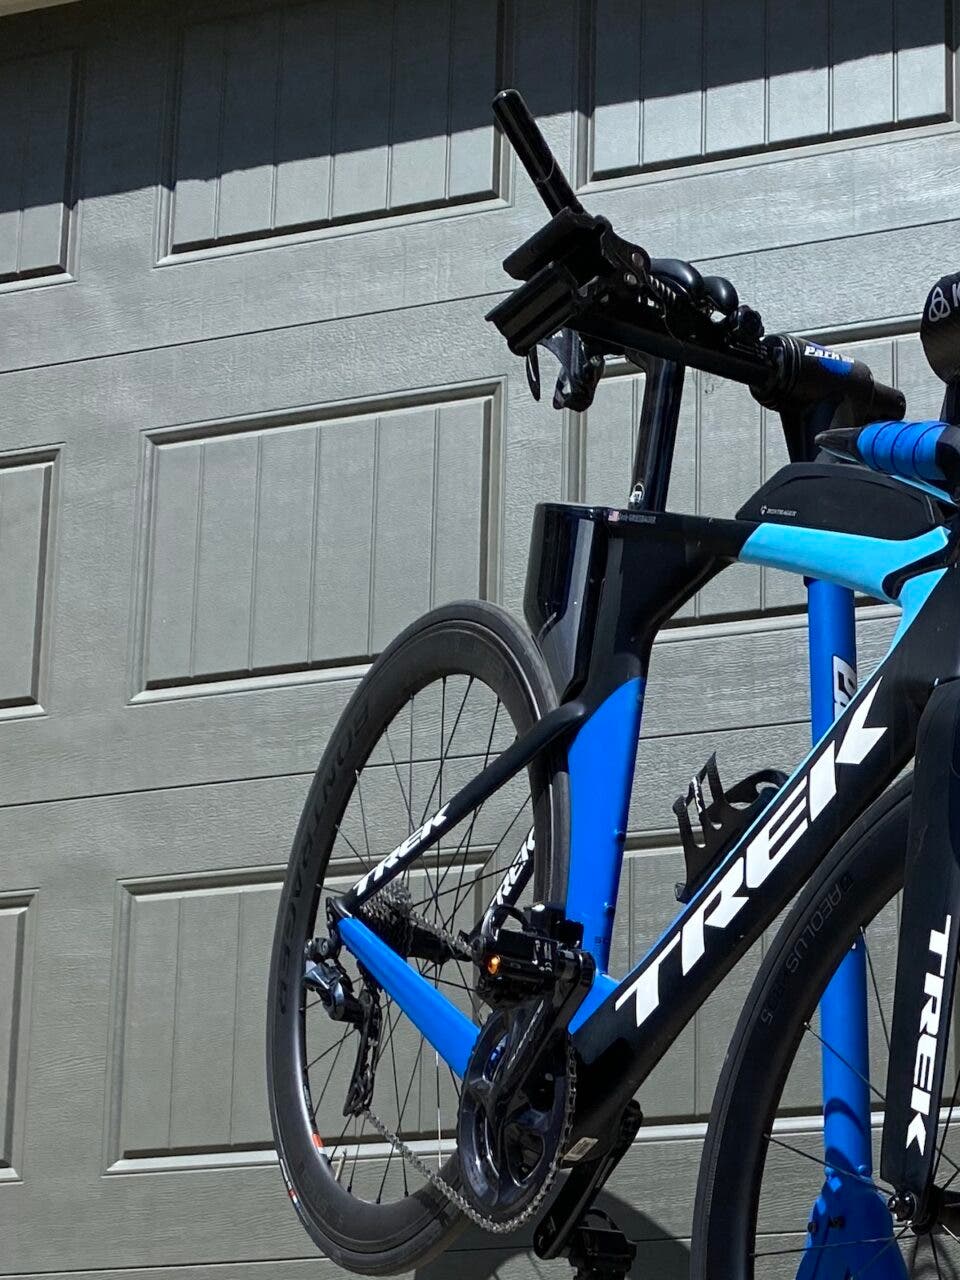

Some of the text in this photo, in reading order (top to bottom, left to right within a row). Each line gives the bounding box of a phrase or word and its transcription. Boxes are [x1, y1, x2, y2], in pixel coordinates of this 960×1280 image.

[353, 801, 451, 896] TREK
[615, 676, 888, 1028] TREK
[785, 882, 842, 974] AEOLUS
[905, 914, 951, 1156] TREK
